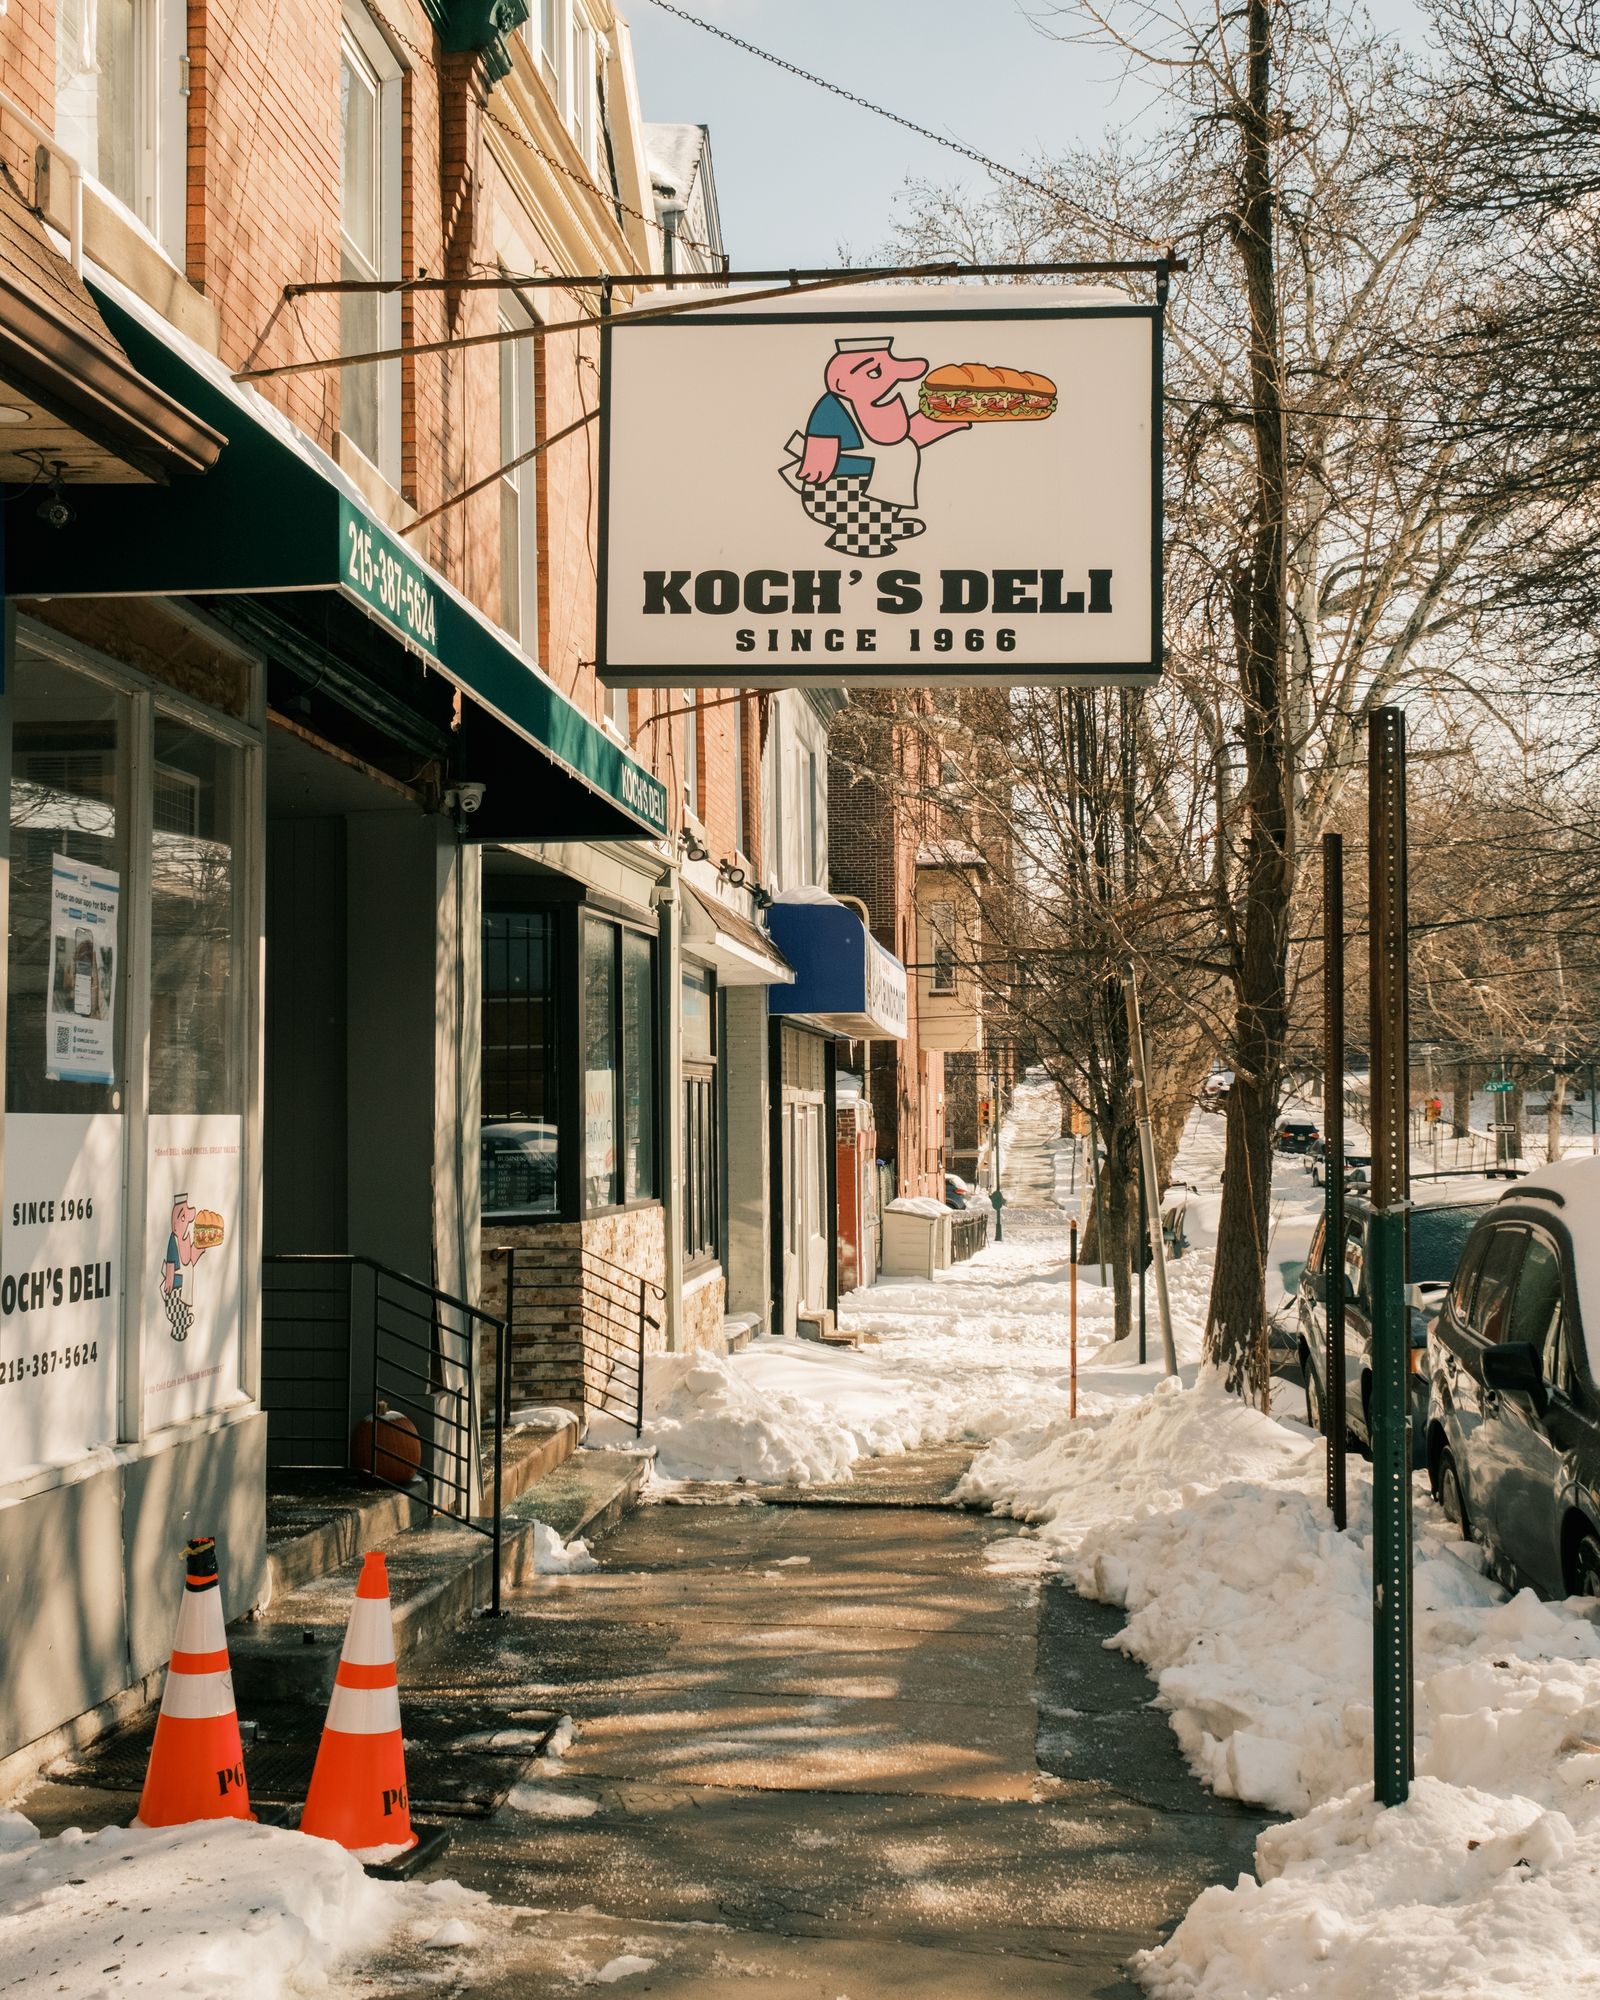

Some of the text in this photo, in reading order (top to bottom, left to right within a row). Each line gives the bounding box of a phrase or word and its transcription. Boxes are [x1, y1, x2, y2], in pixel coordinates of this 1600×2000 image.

[348, 519, 437, 646] 215-387-5624
[642, 568, 1113, 615] KOCH'S DELI
[735, 627, 1017, 653] SINCE 1966
[621, 762, 666, 826] KOCH'S DELI
[12, 1197, 94, 1227] SINCE 1966
[1, 1261, 111, 1316] OCH'S DELI
